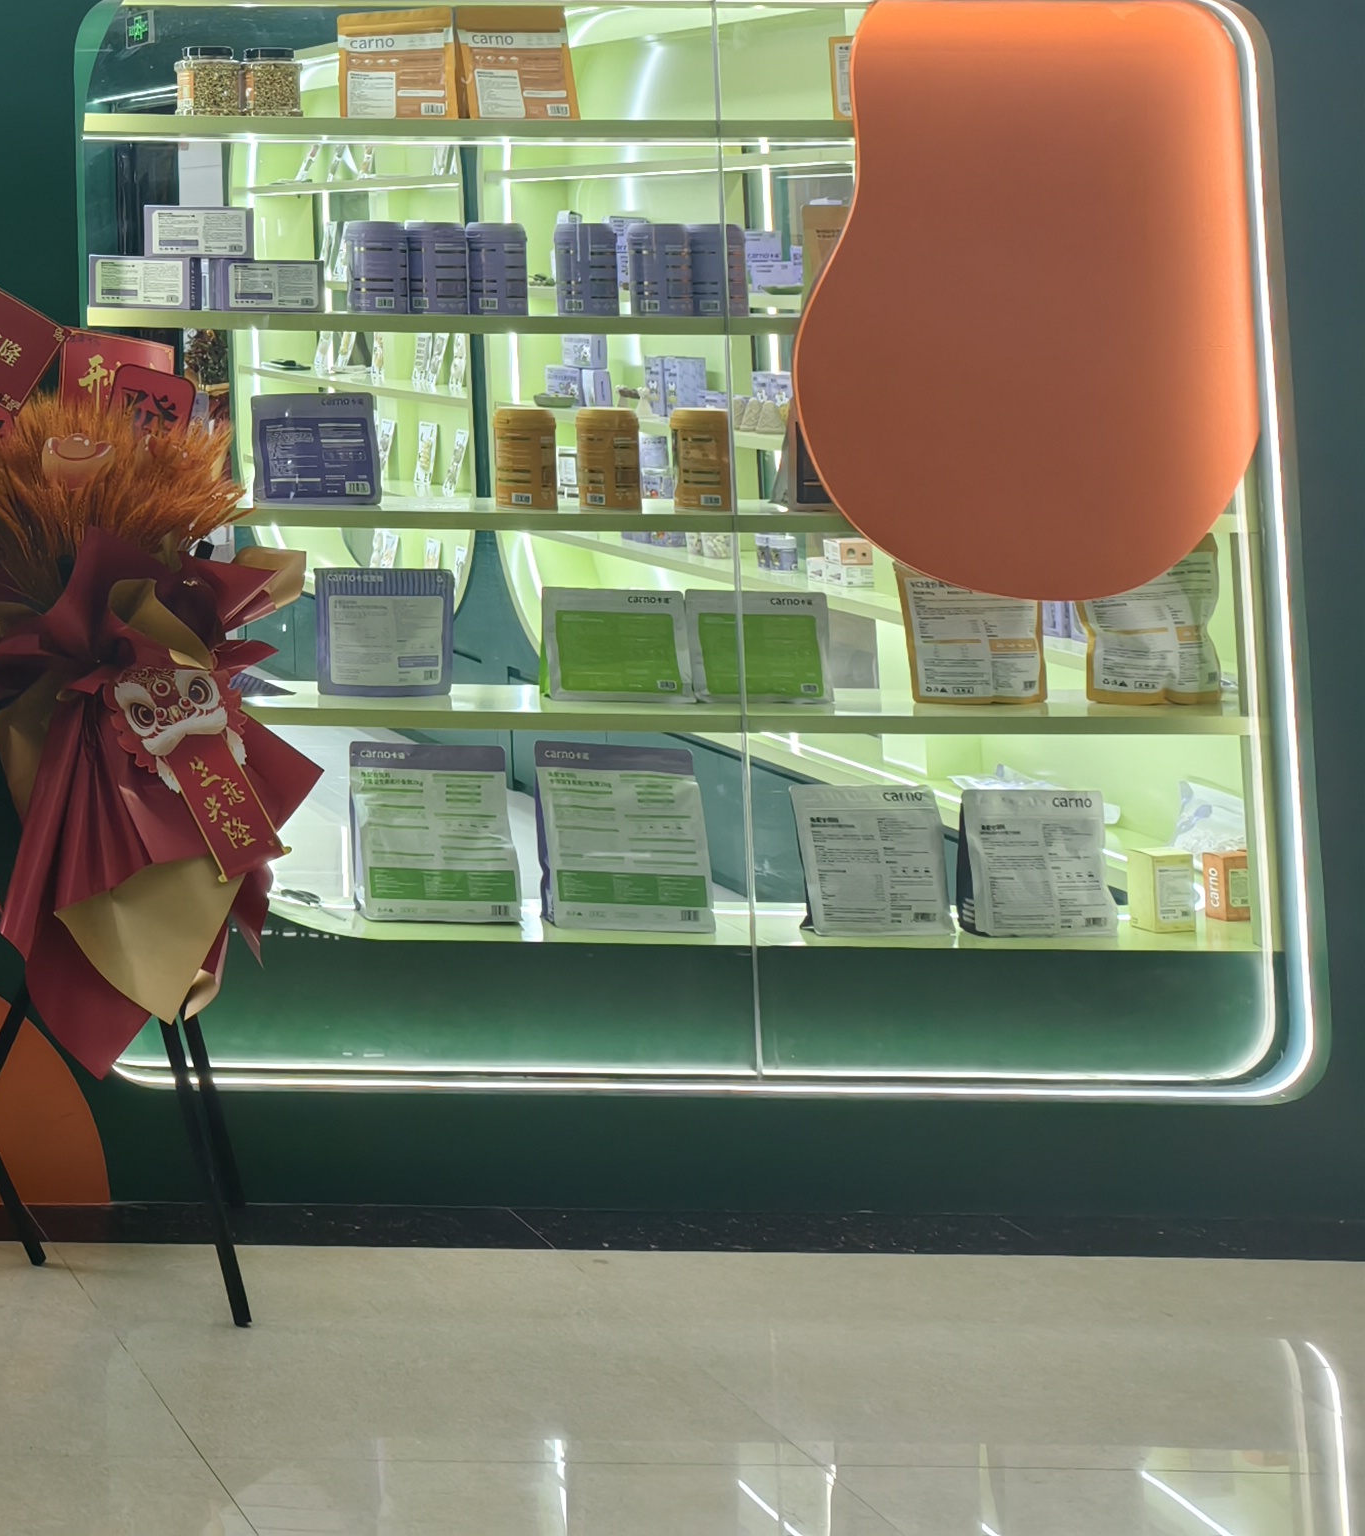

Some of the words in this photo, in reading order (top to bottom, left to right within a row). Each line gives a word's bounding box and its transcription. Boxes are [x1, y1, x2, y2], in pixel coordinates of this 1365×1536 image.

[349, 36, 395, 50] carno
[471, 32, 514, 47] carno
[359, 749, 391, 759] carno
[544, 749, 576, 760] carno
[882, 791, 924, 803] carno
[1052, 796, 1093, 808] carno
[1209, 867, 1220, 908] carno
